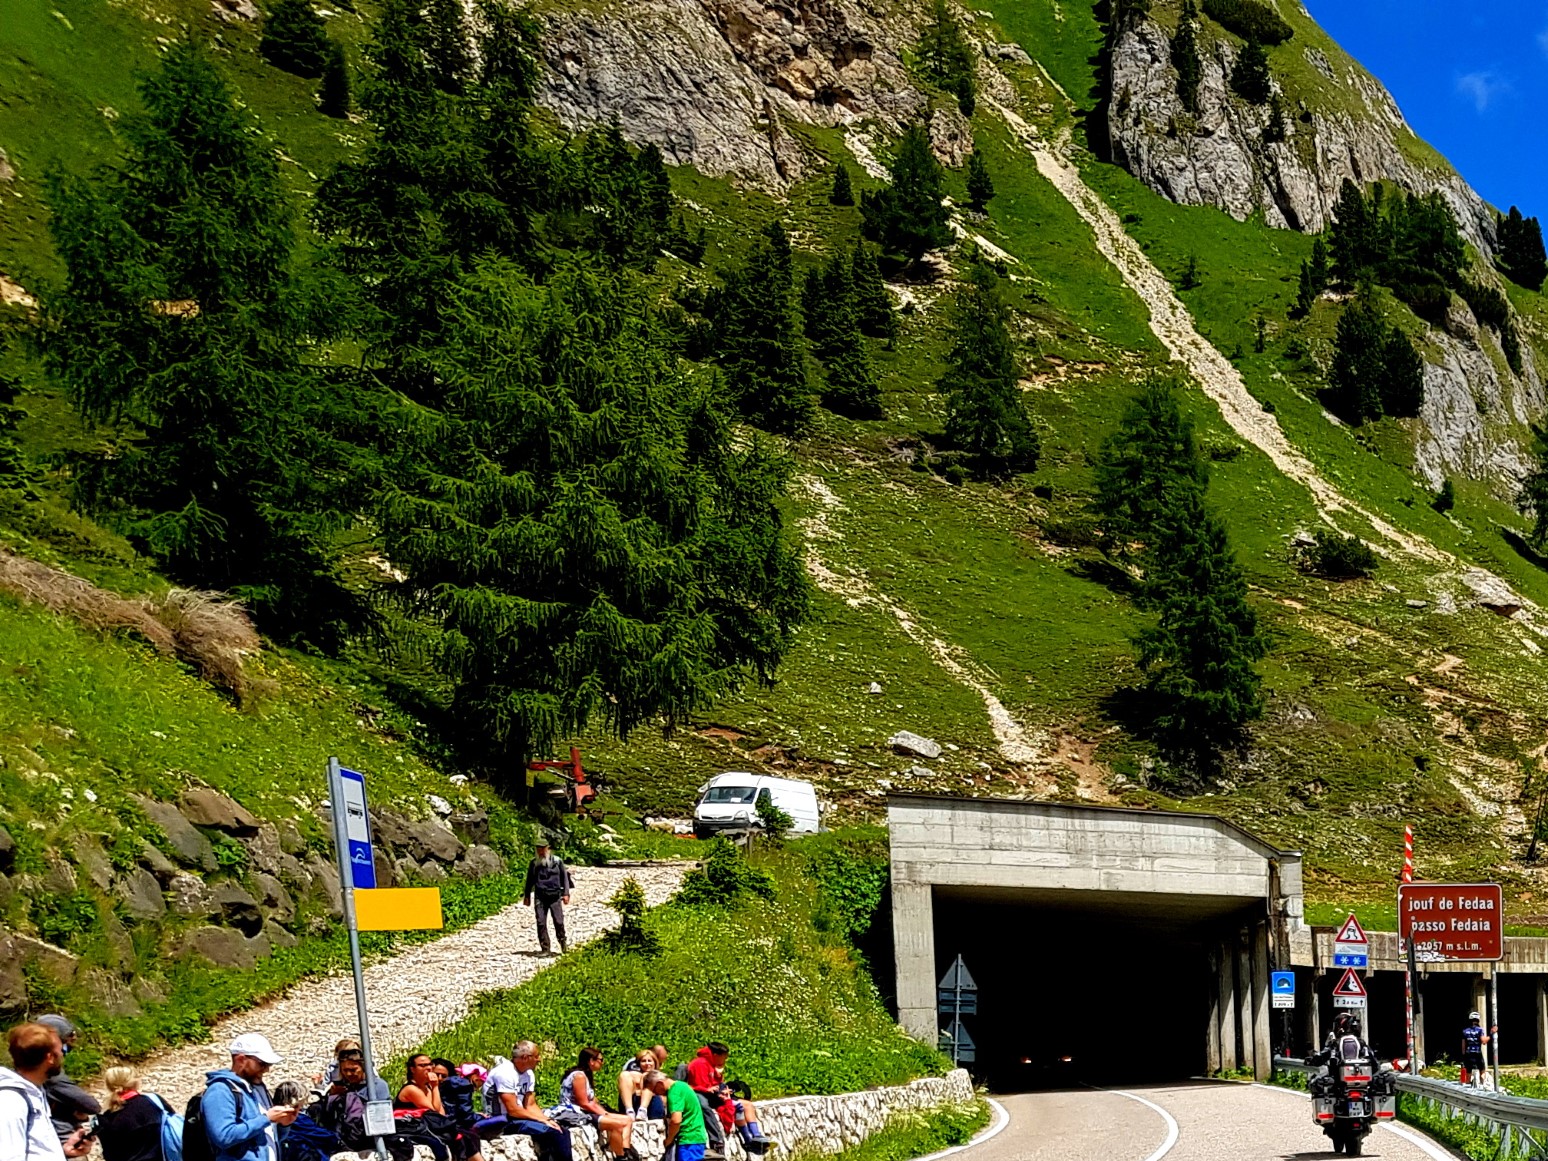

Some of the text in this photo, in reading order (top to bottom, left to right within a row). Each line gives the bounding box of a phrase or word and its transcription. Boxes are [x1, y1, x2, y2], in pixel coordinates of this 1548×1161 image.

[1408, 896, 1495, 911] jouf de Fedaa
[1451, 918, 1491, 932] Fedaia
[1446, 943, 1454, 951] m
